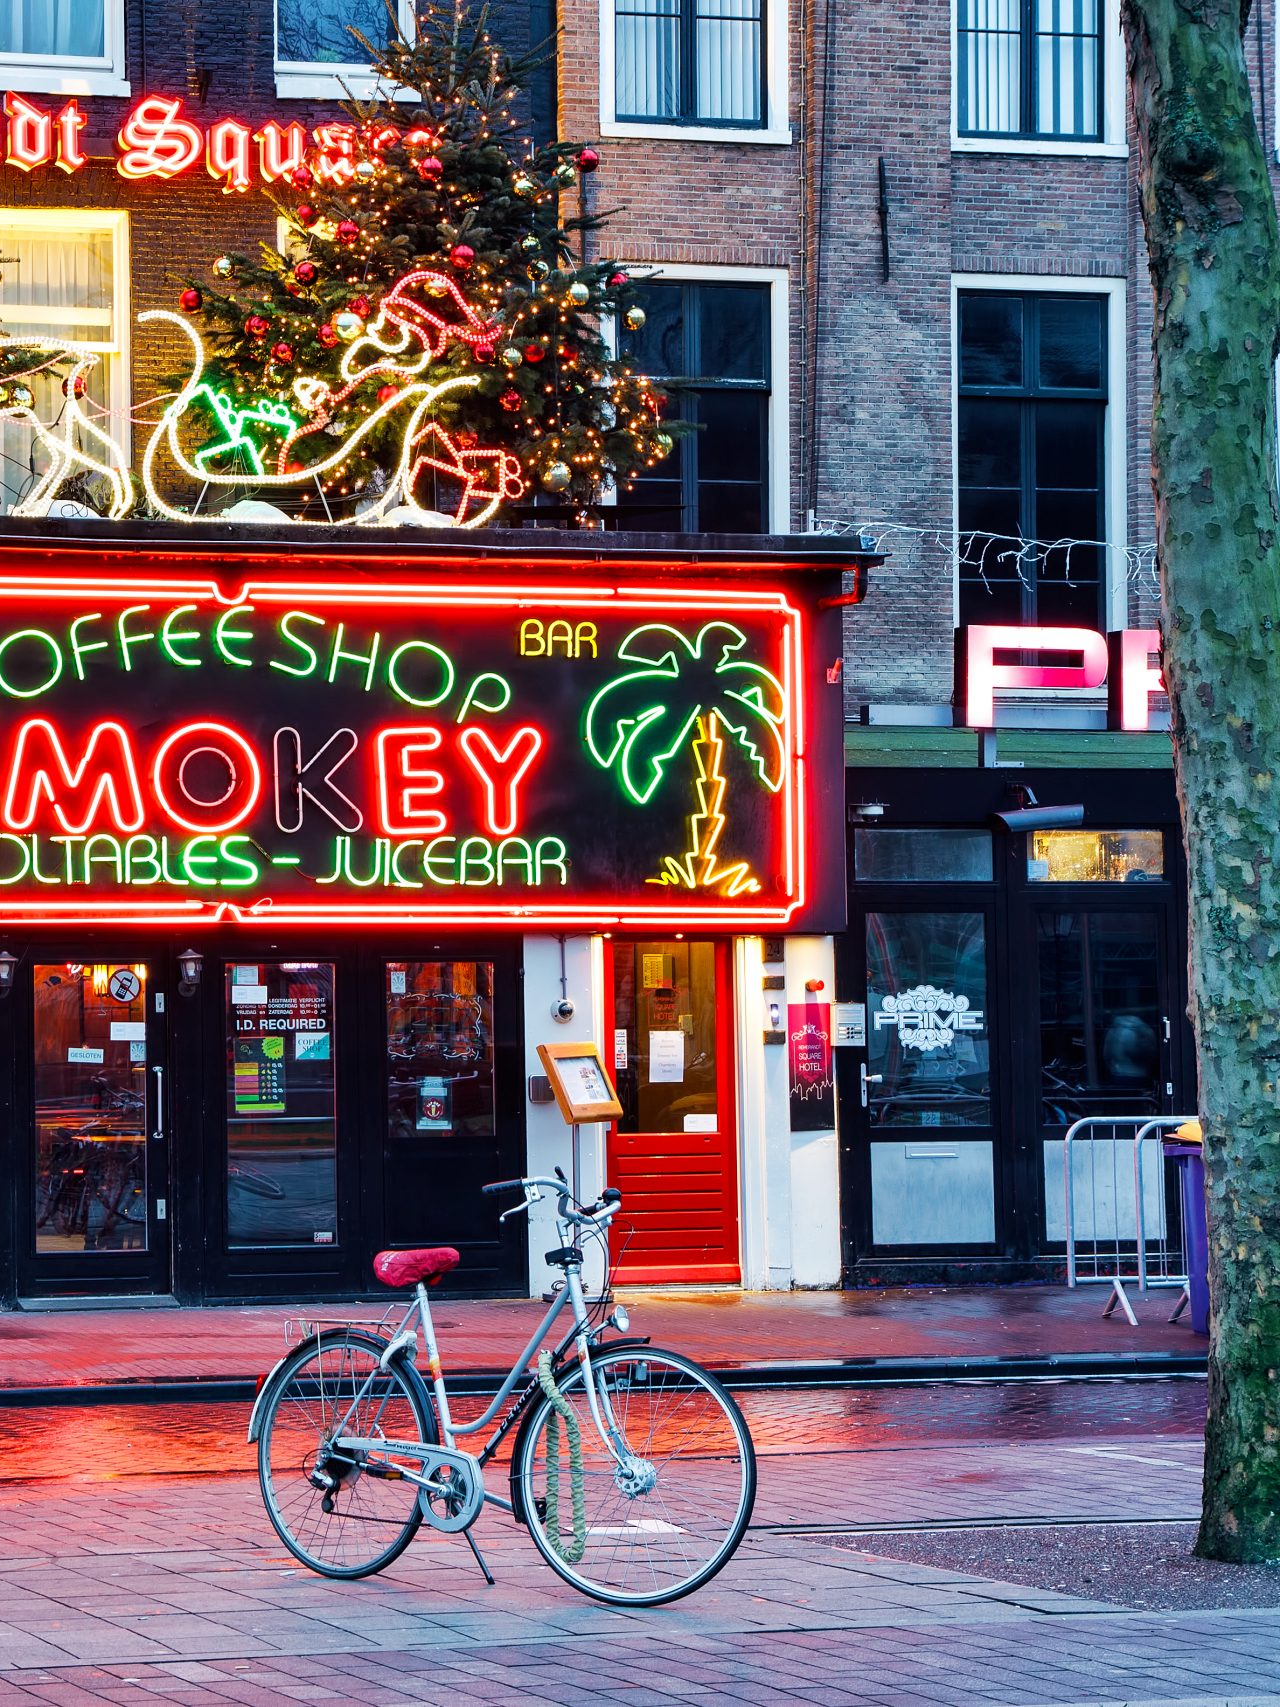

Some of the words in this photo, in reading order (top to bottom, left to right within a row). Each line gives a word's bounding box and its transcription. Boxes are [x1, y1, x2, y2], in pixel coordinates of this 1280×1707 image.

[519, 618, 599, 659] BAR
[315, 836, 570, 888] JUICEBAR
[236, 1019, 256, 1031] I.D.
[259, 1018, 327, 1031] REQUIRED
[873, 1010, 984, 1031] PRIME
[798, 1052, 822, 1061] SQUARE
[798, 1062, 823, 1072] HOTEL
